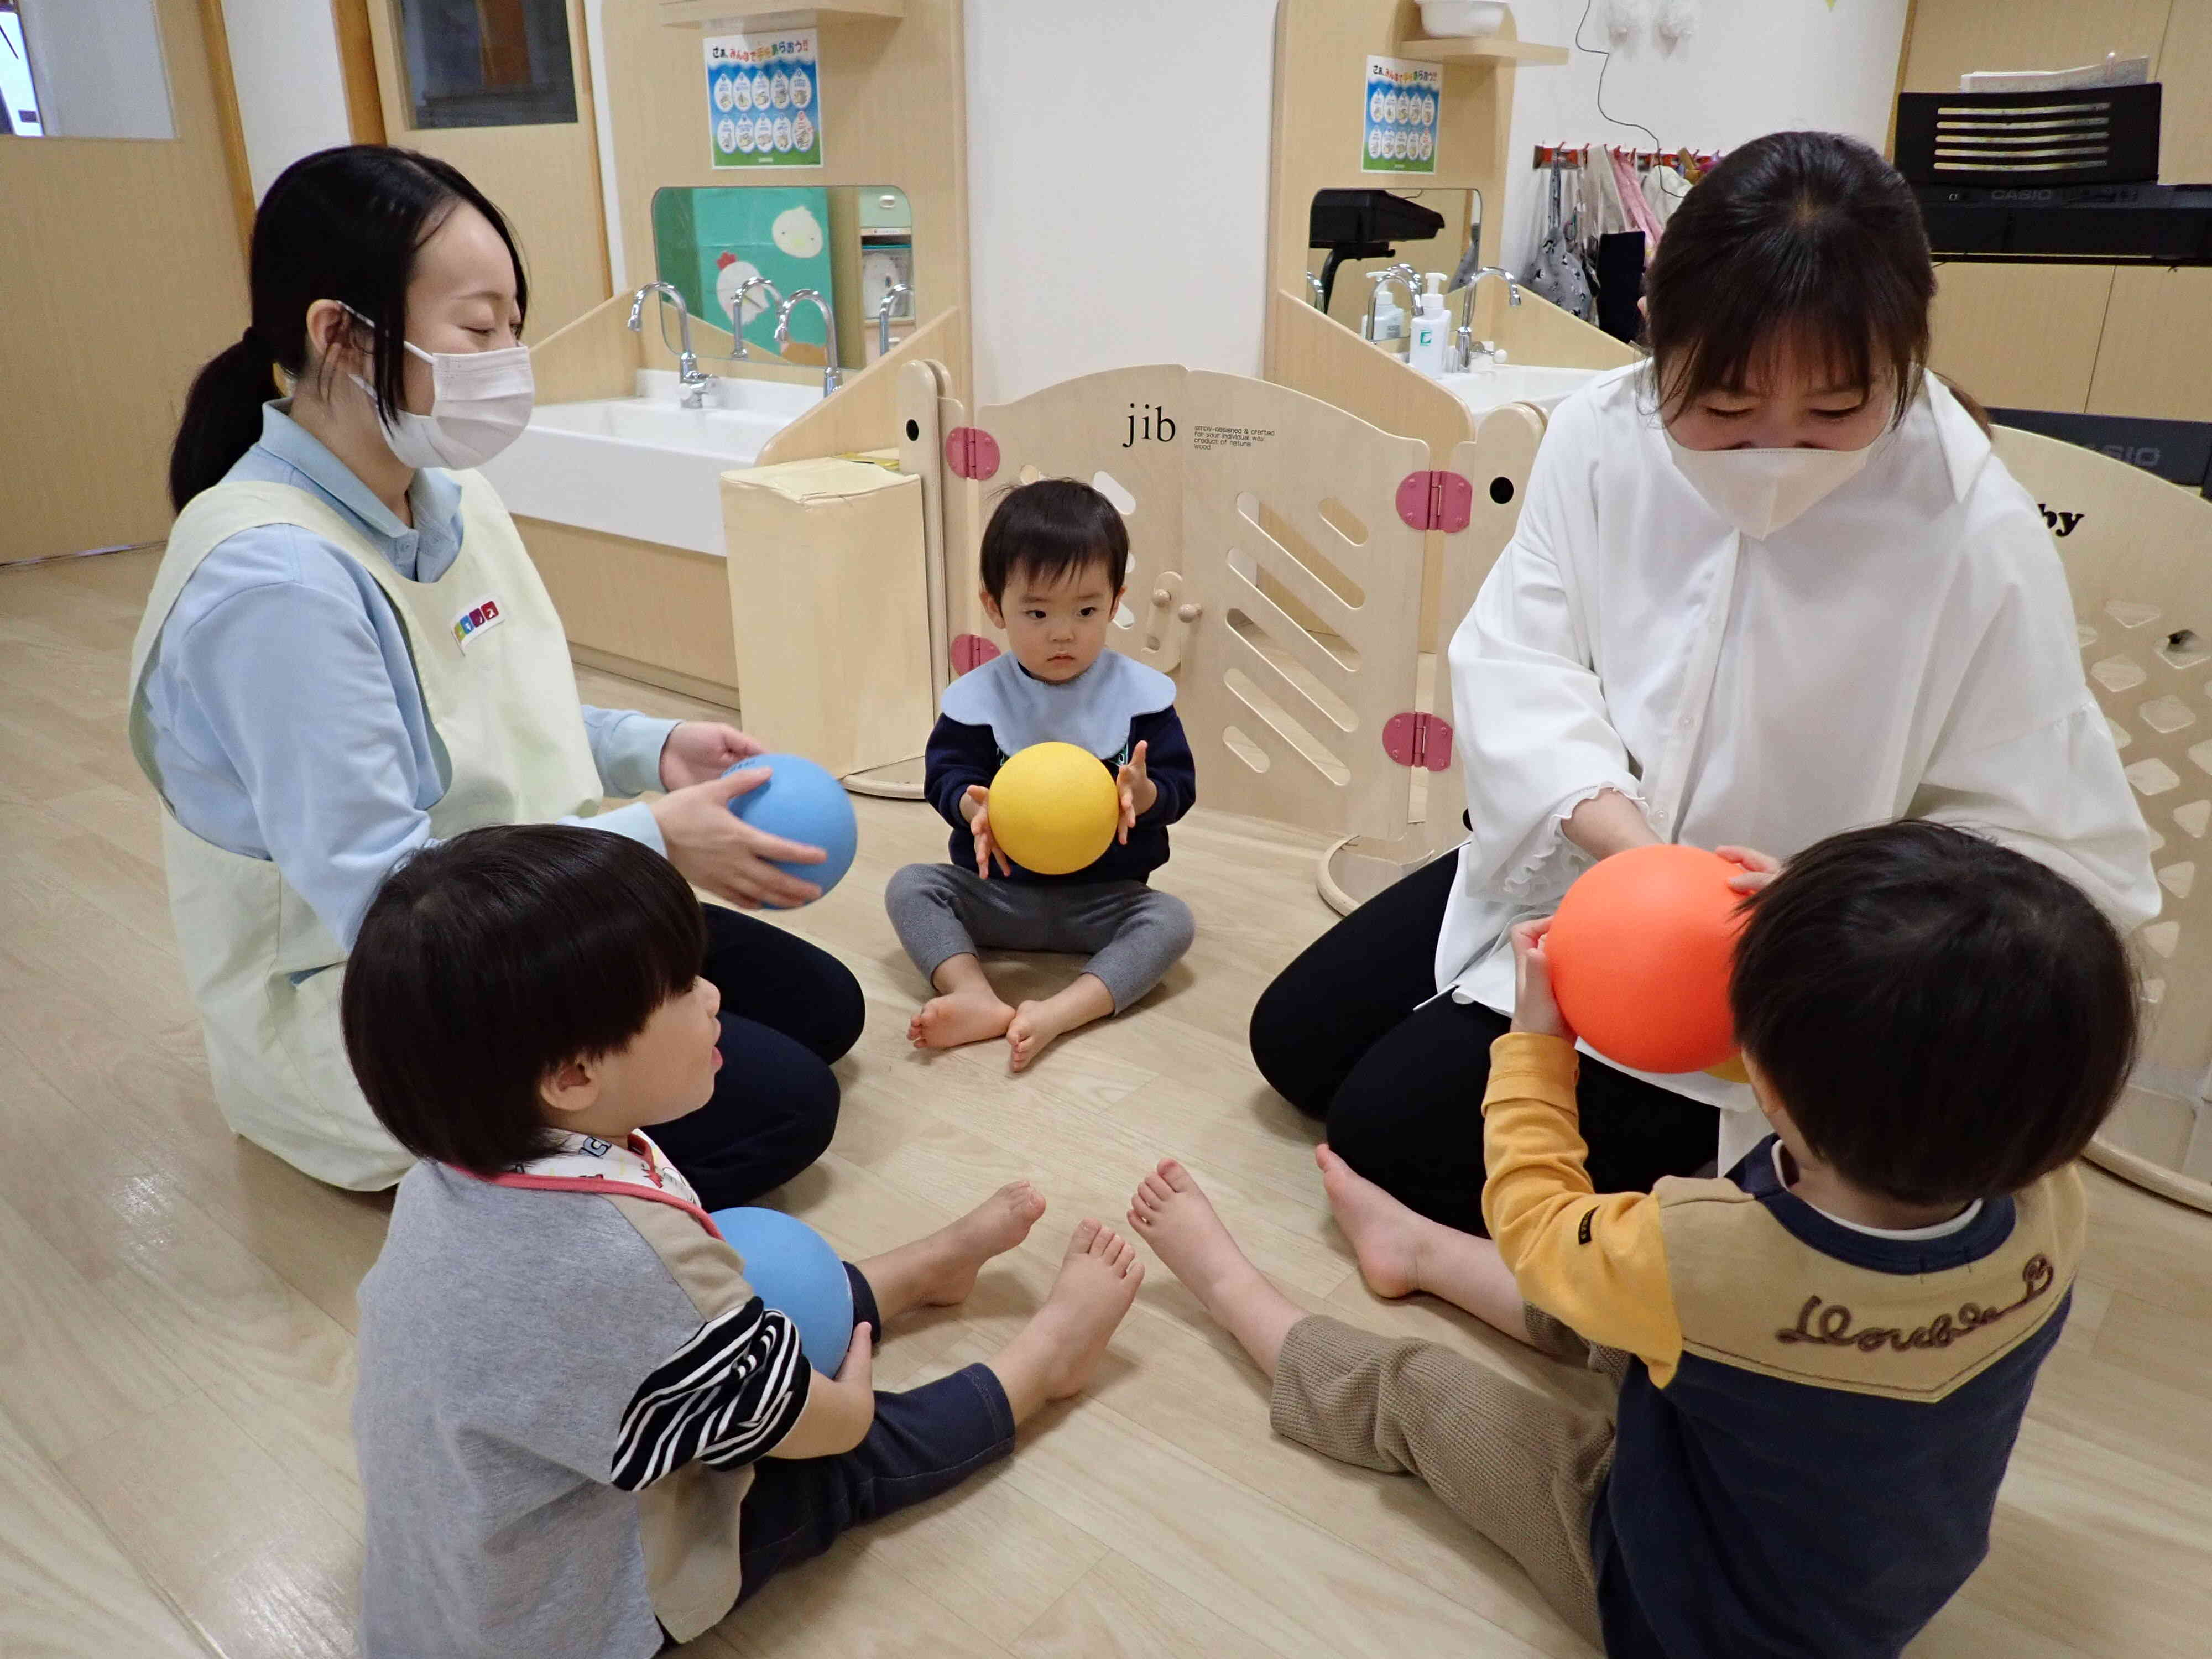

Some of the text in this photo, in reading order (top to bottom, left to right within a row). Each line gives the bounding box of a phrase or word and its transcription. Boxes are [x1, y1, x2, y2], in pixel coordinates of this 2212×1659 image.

[1991, 189, 2052, 200] CASIO
[1122, 403, 1176, 448] jib
[1222, 432, 1249, 441] individual
